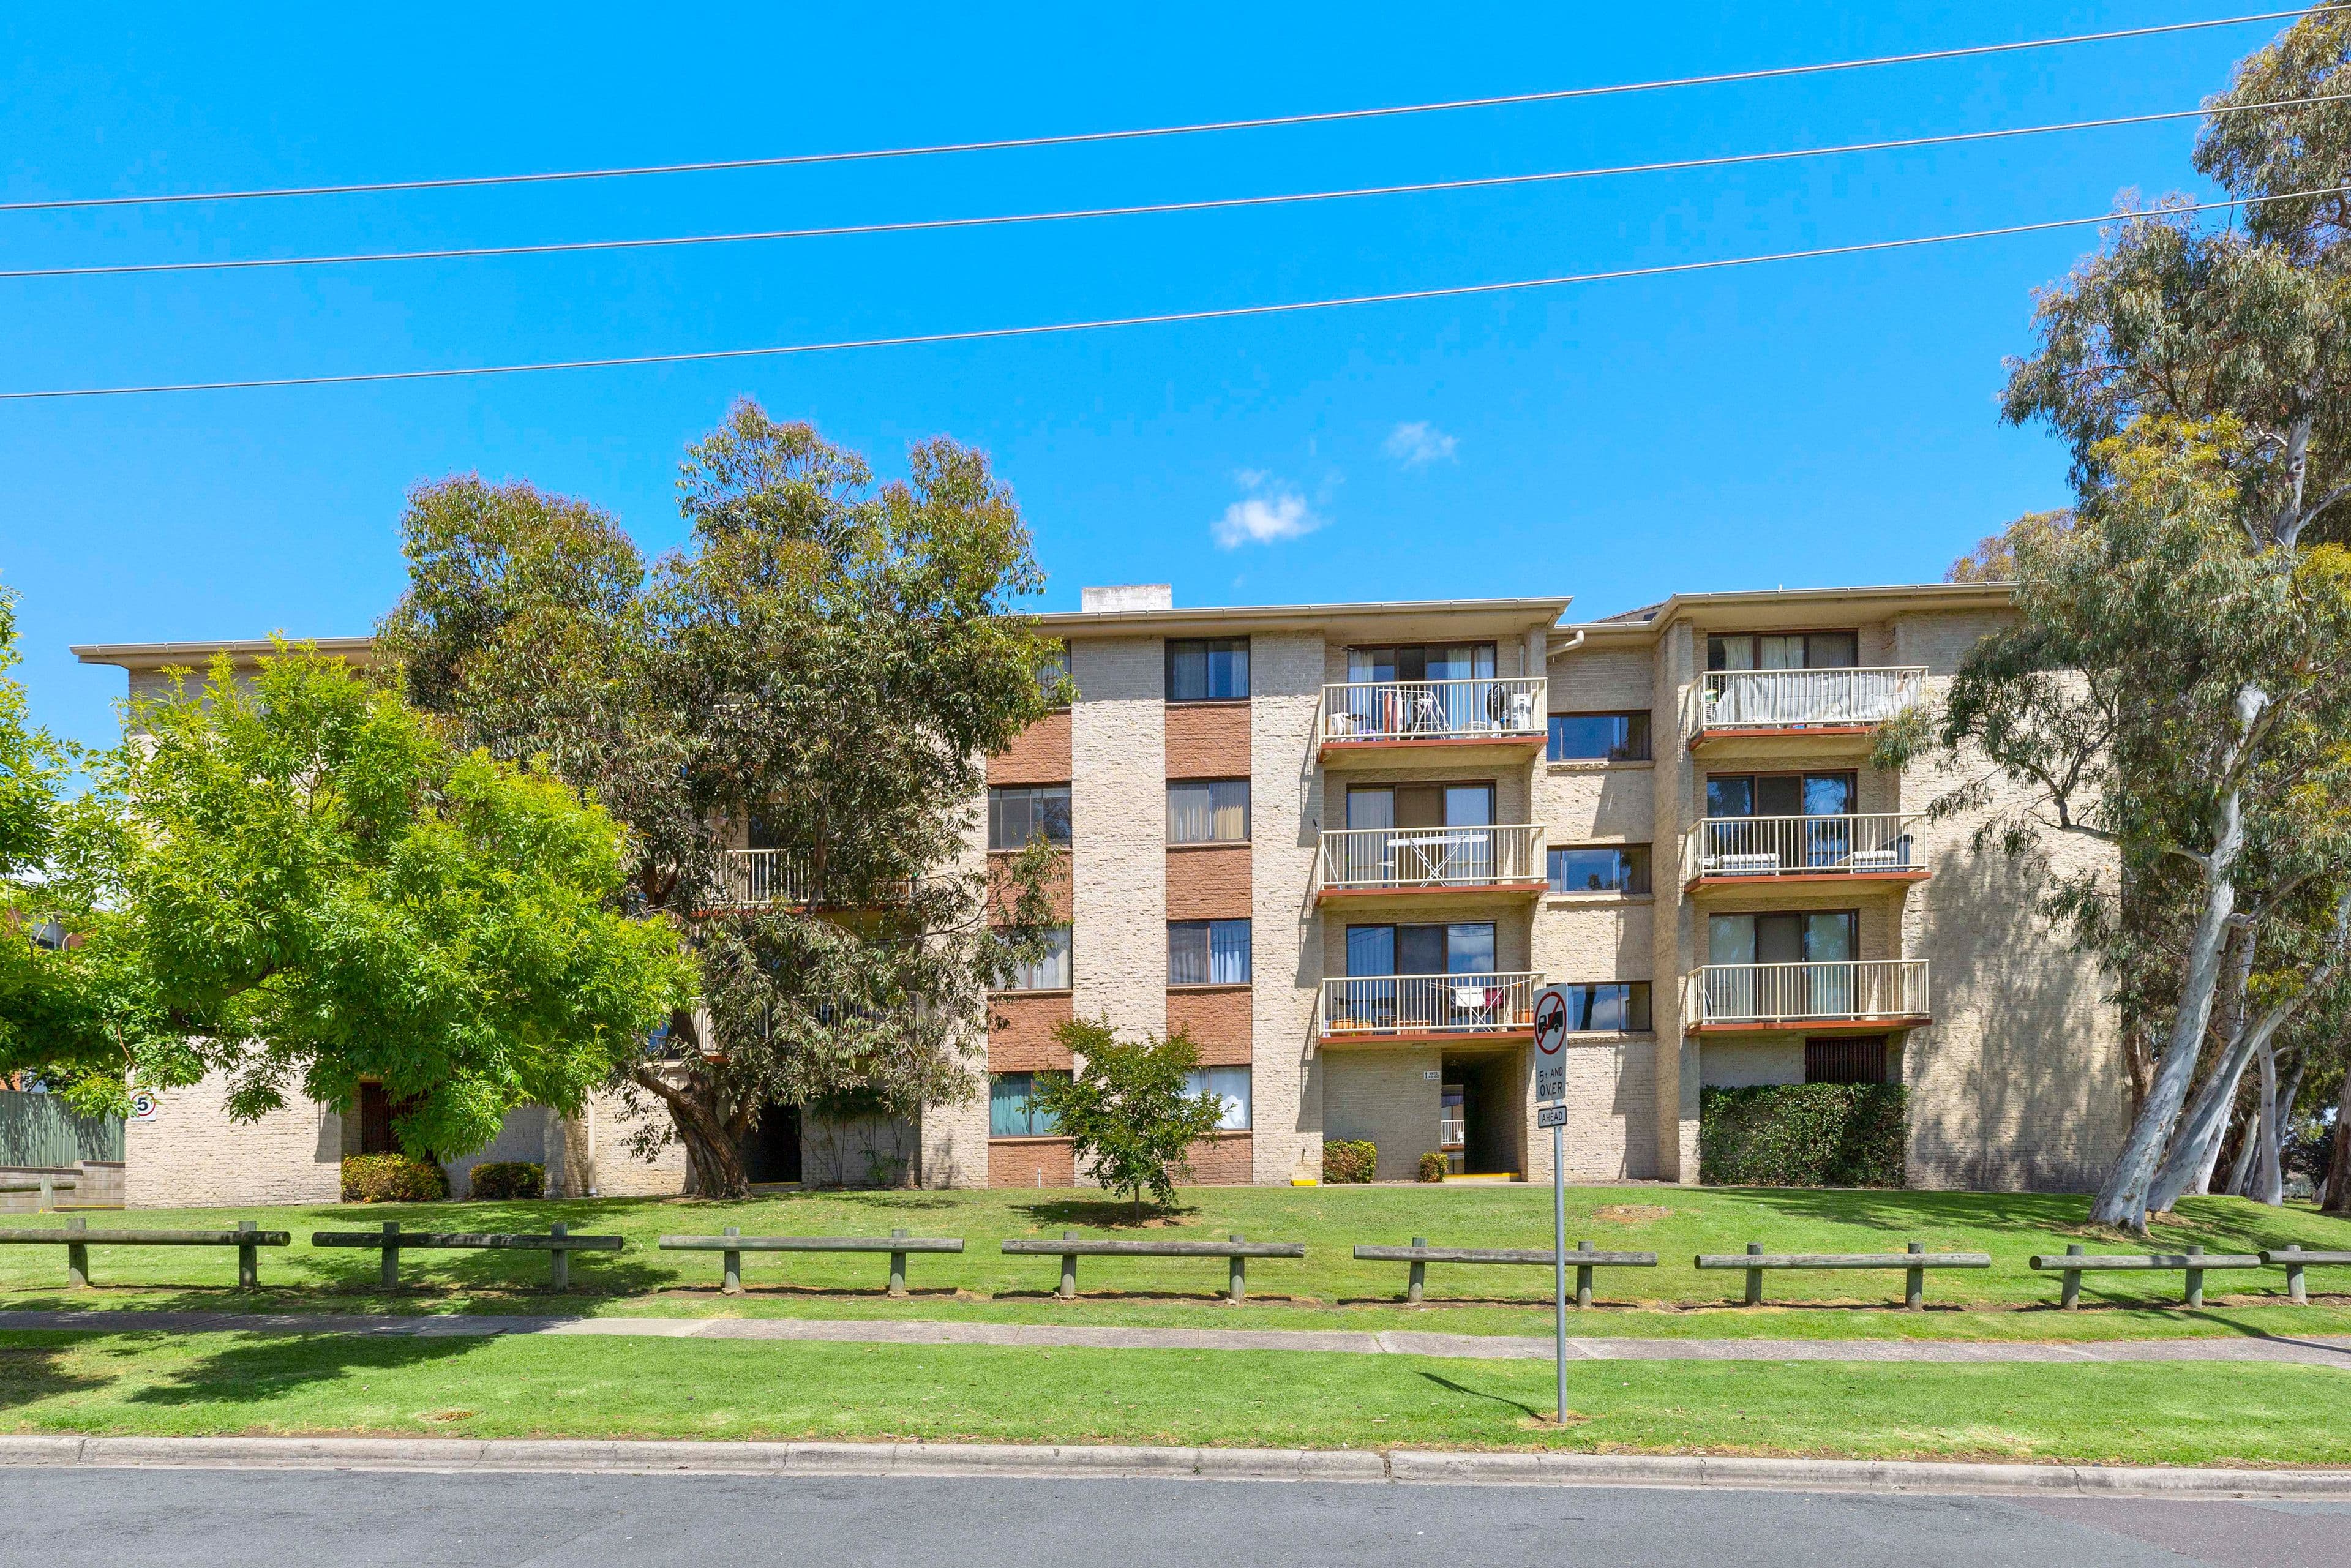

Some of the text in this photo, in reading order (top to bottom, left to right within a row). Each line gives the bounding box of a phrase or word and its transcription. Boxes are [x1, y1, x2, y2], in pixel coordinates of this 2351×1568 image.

[1550, 1067, 1563, 1078] AND
[1540, 1082, 1562, 1097] OVER
[137, 1097, 149, 1111] 5
[1542, 1111, 1563, 1122] AHEAD
